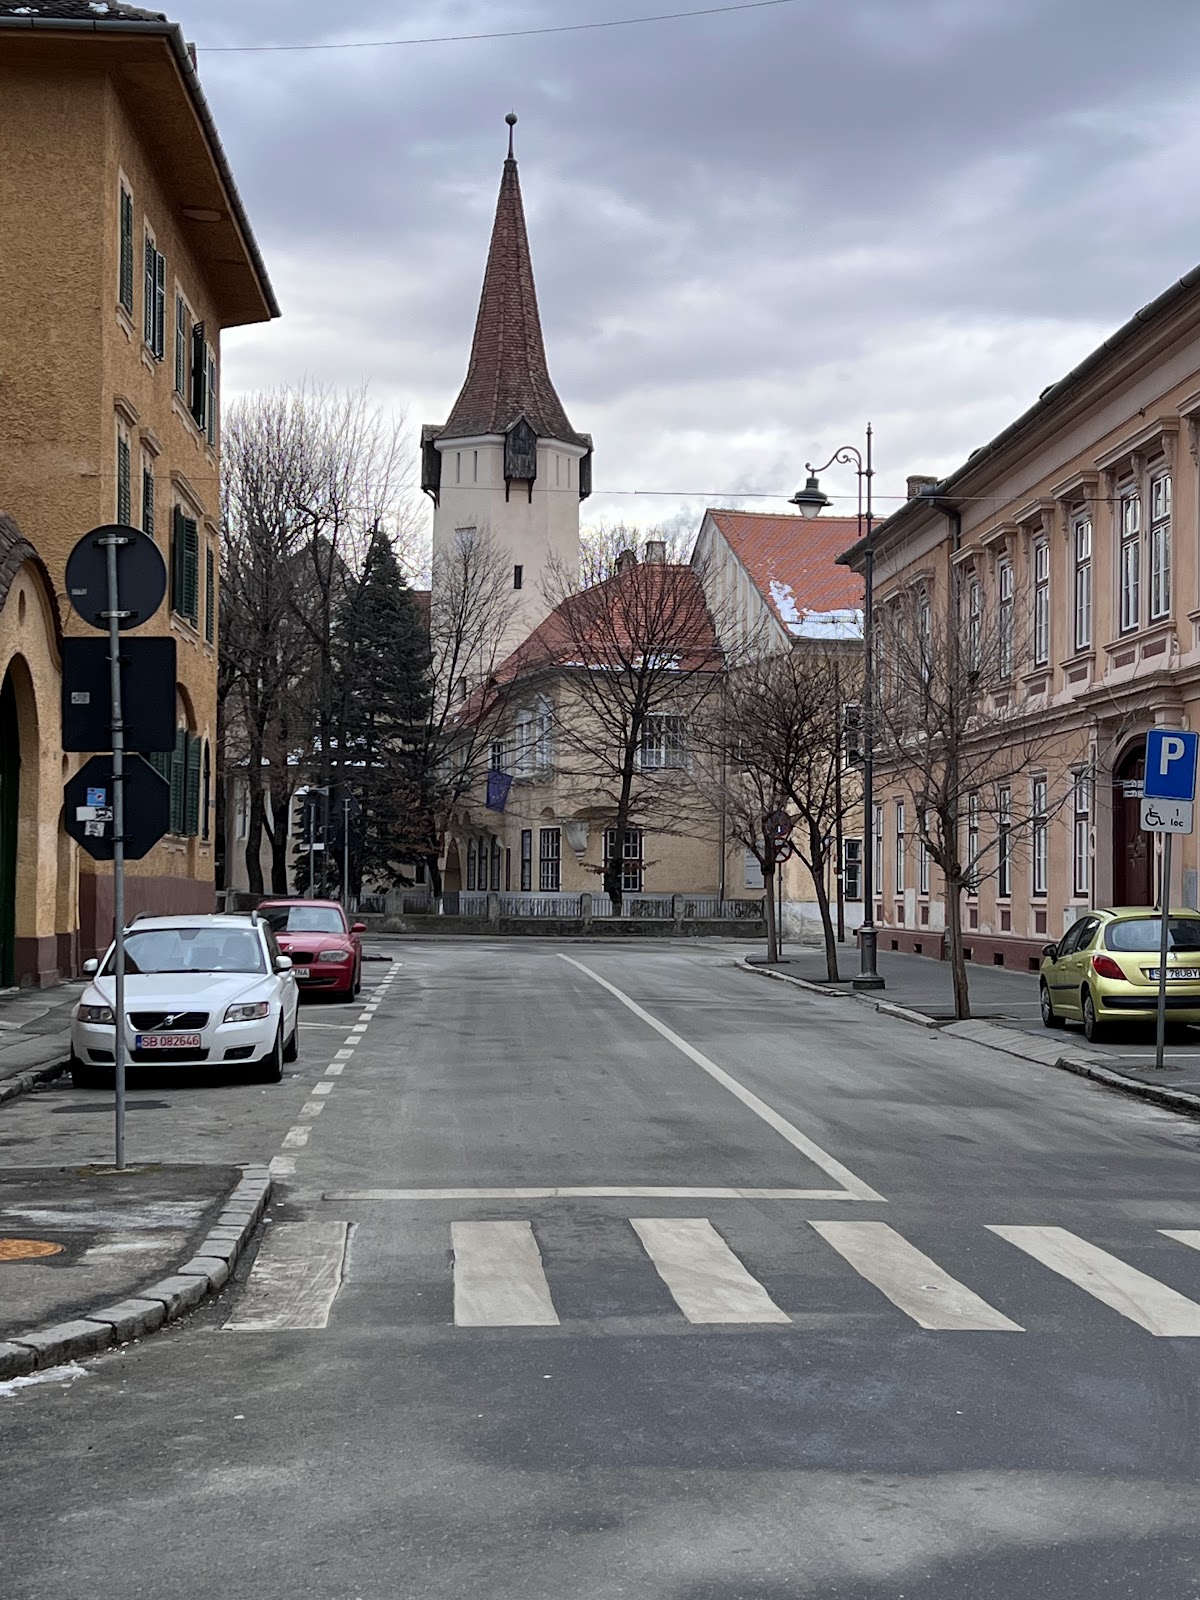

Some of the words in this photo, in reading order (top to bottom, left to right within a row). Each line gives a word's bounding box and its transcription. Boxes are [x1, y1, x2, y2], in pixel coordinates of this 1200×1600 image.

[1160, 736, 1185, 775] P
[1175, 808, 1179, 816] 1
[1170, 818, 1184, 827] loc
[142, 1036, 158, 1047] SB
[160, 1035, 199, 1046] 082646
